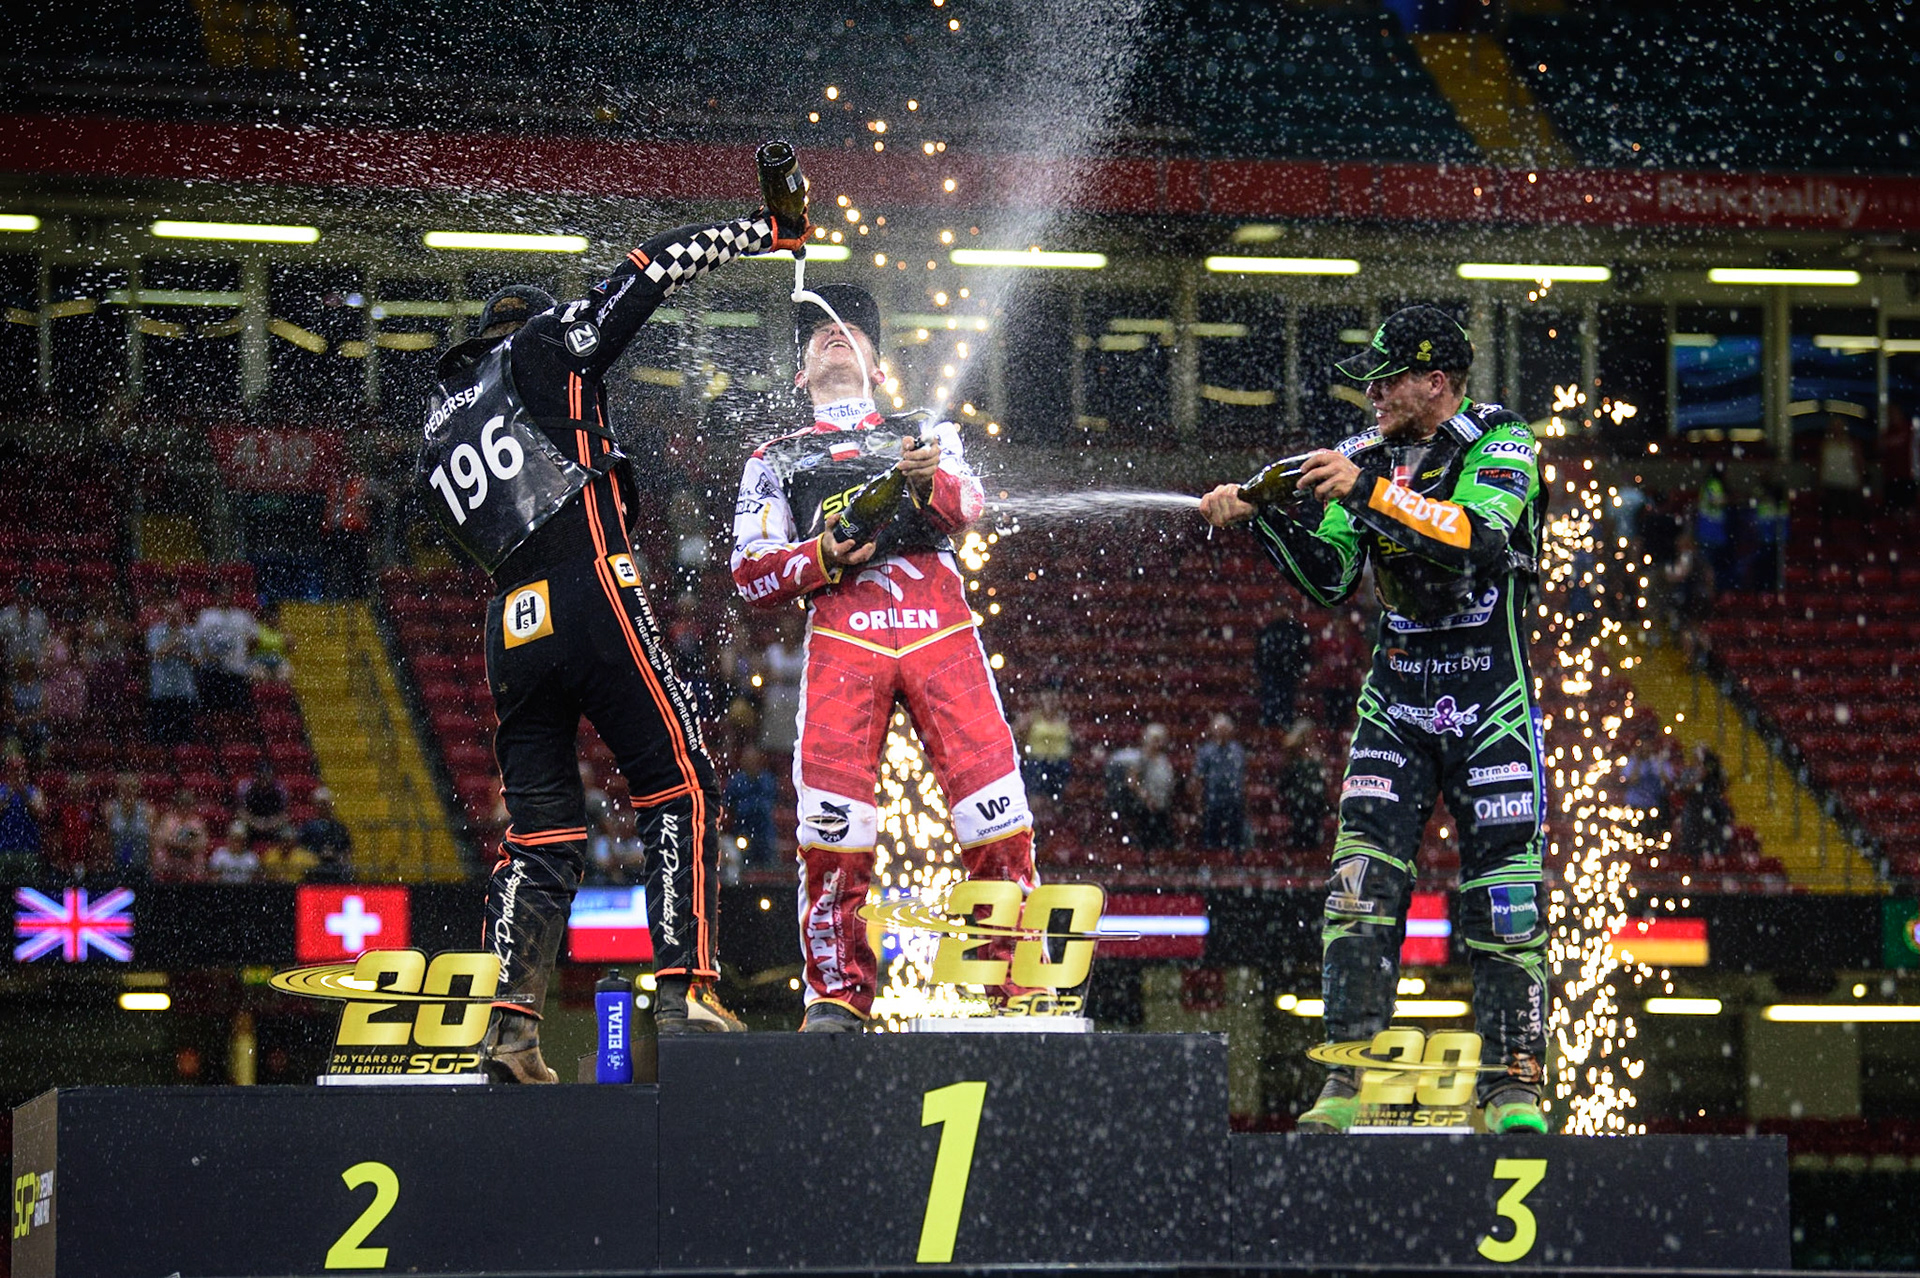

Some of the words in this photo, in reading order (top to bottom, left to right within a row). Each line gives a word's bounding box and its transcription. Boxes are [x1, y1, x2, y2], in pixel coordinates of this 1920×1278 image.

[1658, 177, 1866, 228] Principality
[424, 382, 484, 440] PEDERSEN
[429, 415, 524, 526] 196
[634, 587, 659, 632] HARRY
[849, 609, 938, 631] ORLEN
[1461, 655, 1491, 671] Byg
[1353, 748, 1407, 768] bakertilly
[1474, 792, 1533, 819] Orloff
[658, 849, 681, 946] Products.pl
[929, 880, 1104, 988] 20
[336, 950, 501, 1047] 20
[608, 1001, 623, 1050] ELTAL
[330, 1066, 351, 1074] FIM
[354, 1066, 403, 1074] BRITISH
[333, 1055, 347, 1063] 20
[351, 1055, 388, 1063] YEARS
[391, 1055, 407, 1063] OF
[406, 1054, 480, 1074] SGP
[1359, 1030, 1482, 1105] 20
[1412, 1111, 1468, 1127] SGP
[917, 1082, 986, 1262] 1
[325, 1162, 400, 1269] 2
[1477, 1159, 1547, 1263] 3
